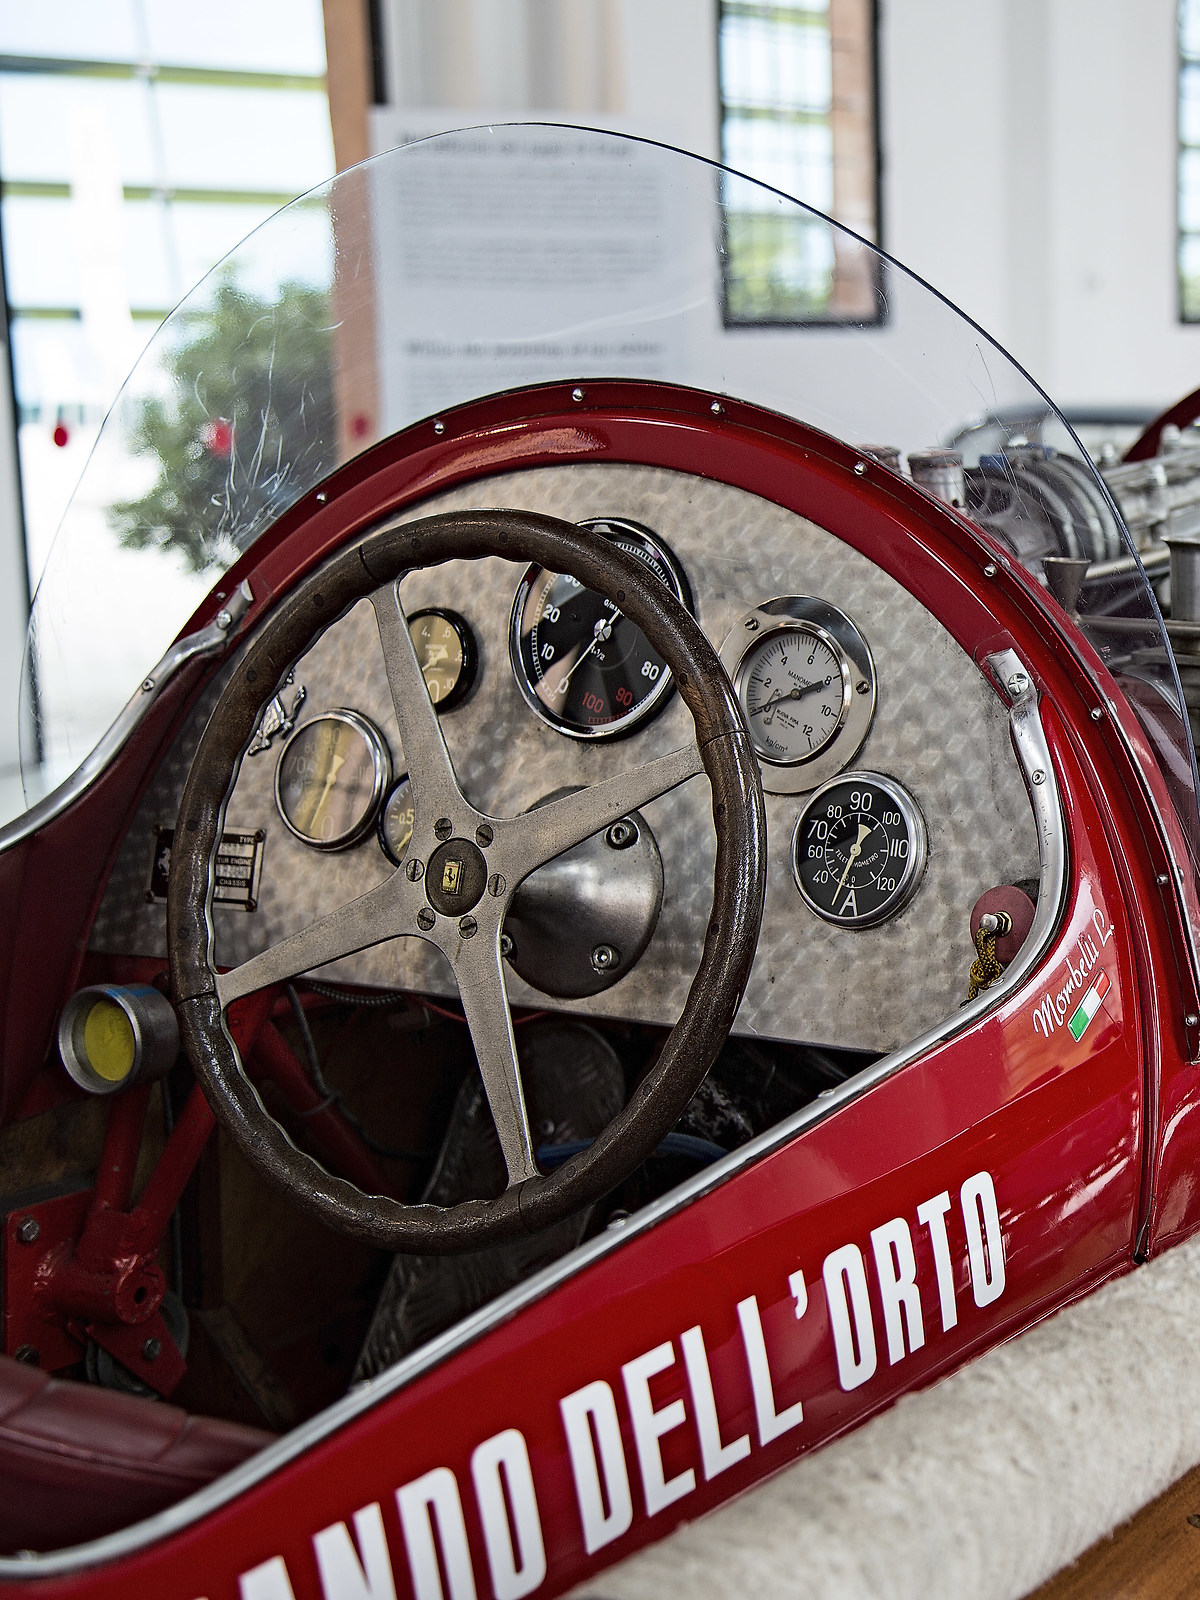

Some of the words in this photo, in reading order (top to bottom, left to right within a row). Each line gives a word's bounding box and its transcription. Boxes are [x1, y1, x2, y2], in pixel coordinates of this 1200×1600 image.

[543, 604, 560, 623] 20
[541, 643, 555, 660] 10
[780, 656, 788, 666] 4
[807, 655, 815, 665] 6
[641, 661, 660, 681] 80
[764, 677, 772, 688] 2
[824, 675, 833, 685] 8
[581, 691, 604, 713] 100
[616, 688, 633, 706] 90
[820, 704, 832, 717] 10
[802, 724, 813, 737] 12
[850, 791, 873, 811] 90
[827, 804, 842, 819] 80
[883, 811, 900, 825] 100
[807, 820, 828, 840] 70
[808, 845, 823, 858] 60
[890, 838, 909, 858] 110
[813, 870, 828, 884] 40
[877, 877, 896, 891] 120
[838, 889, 857, 917] A
[560, 1169, 1007, 1555] DELL'ORTO
